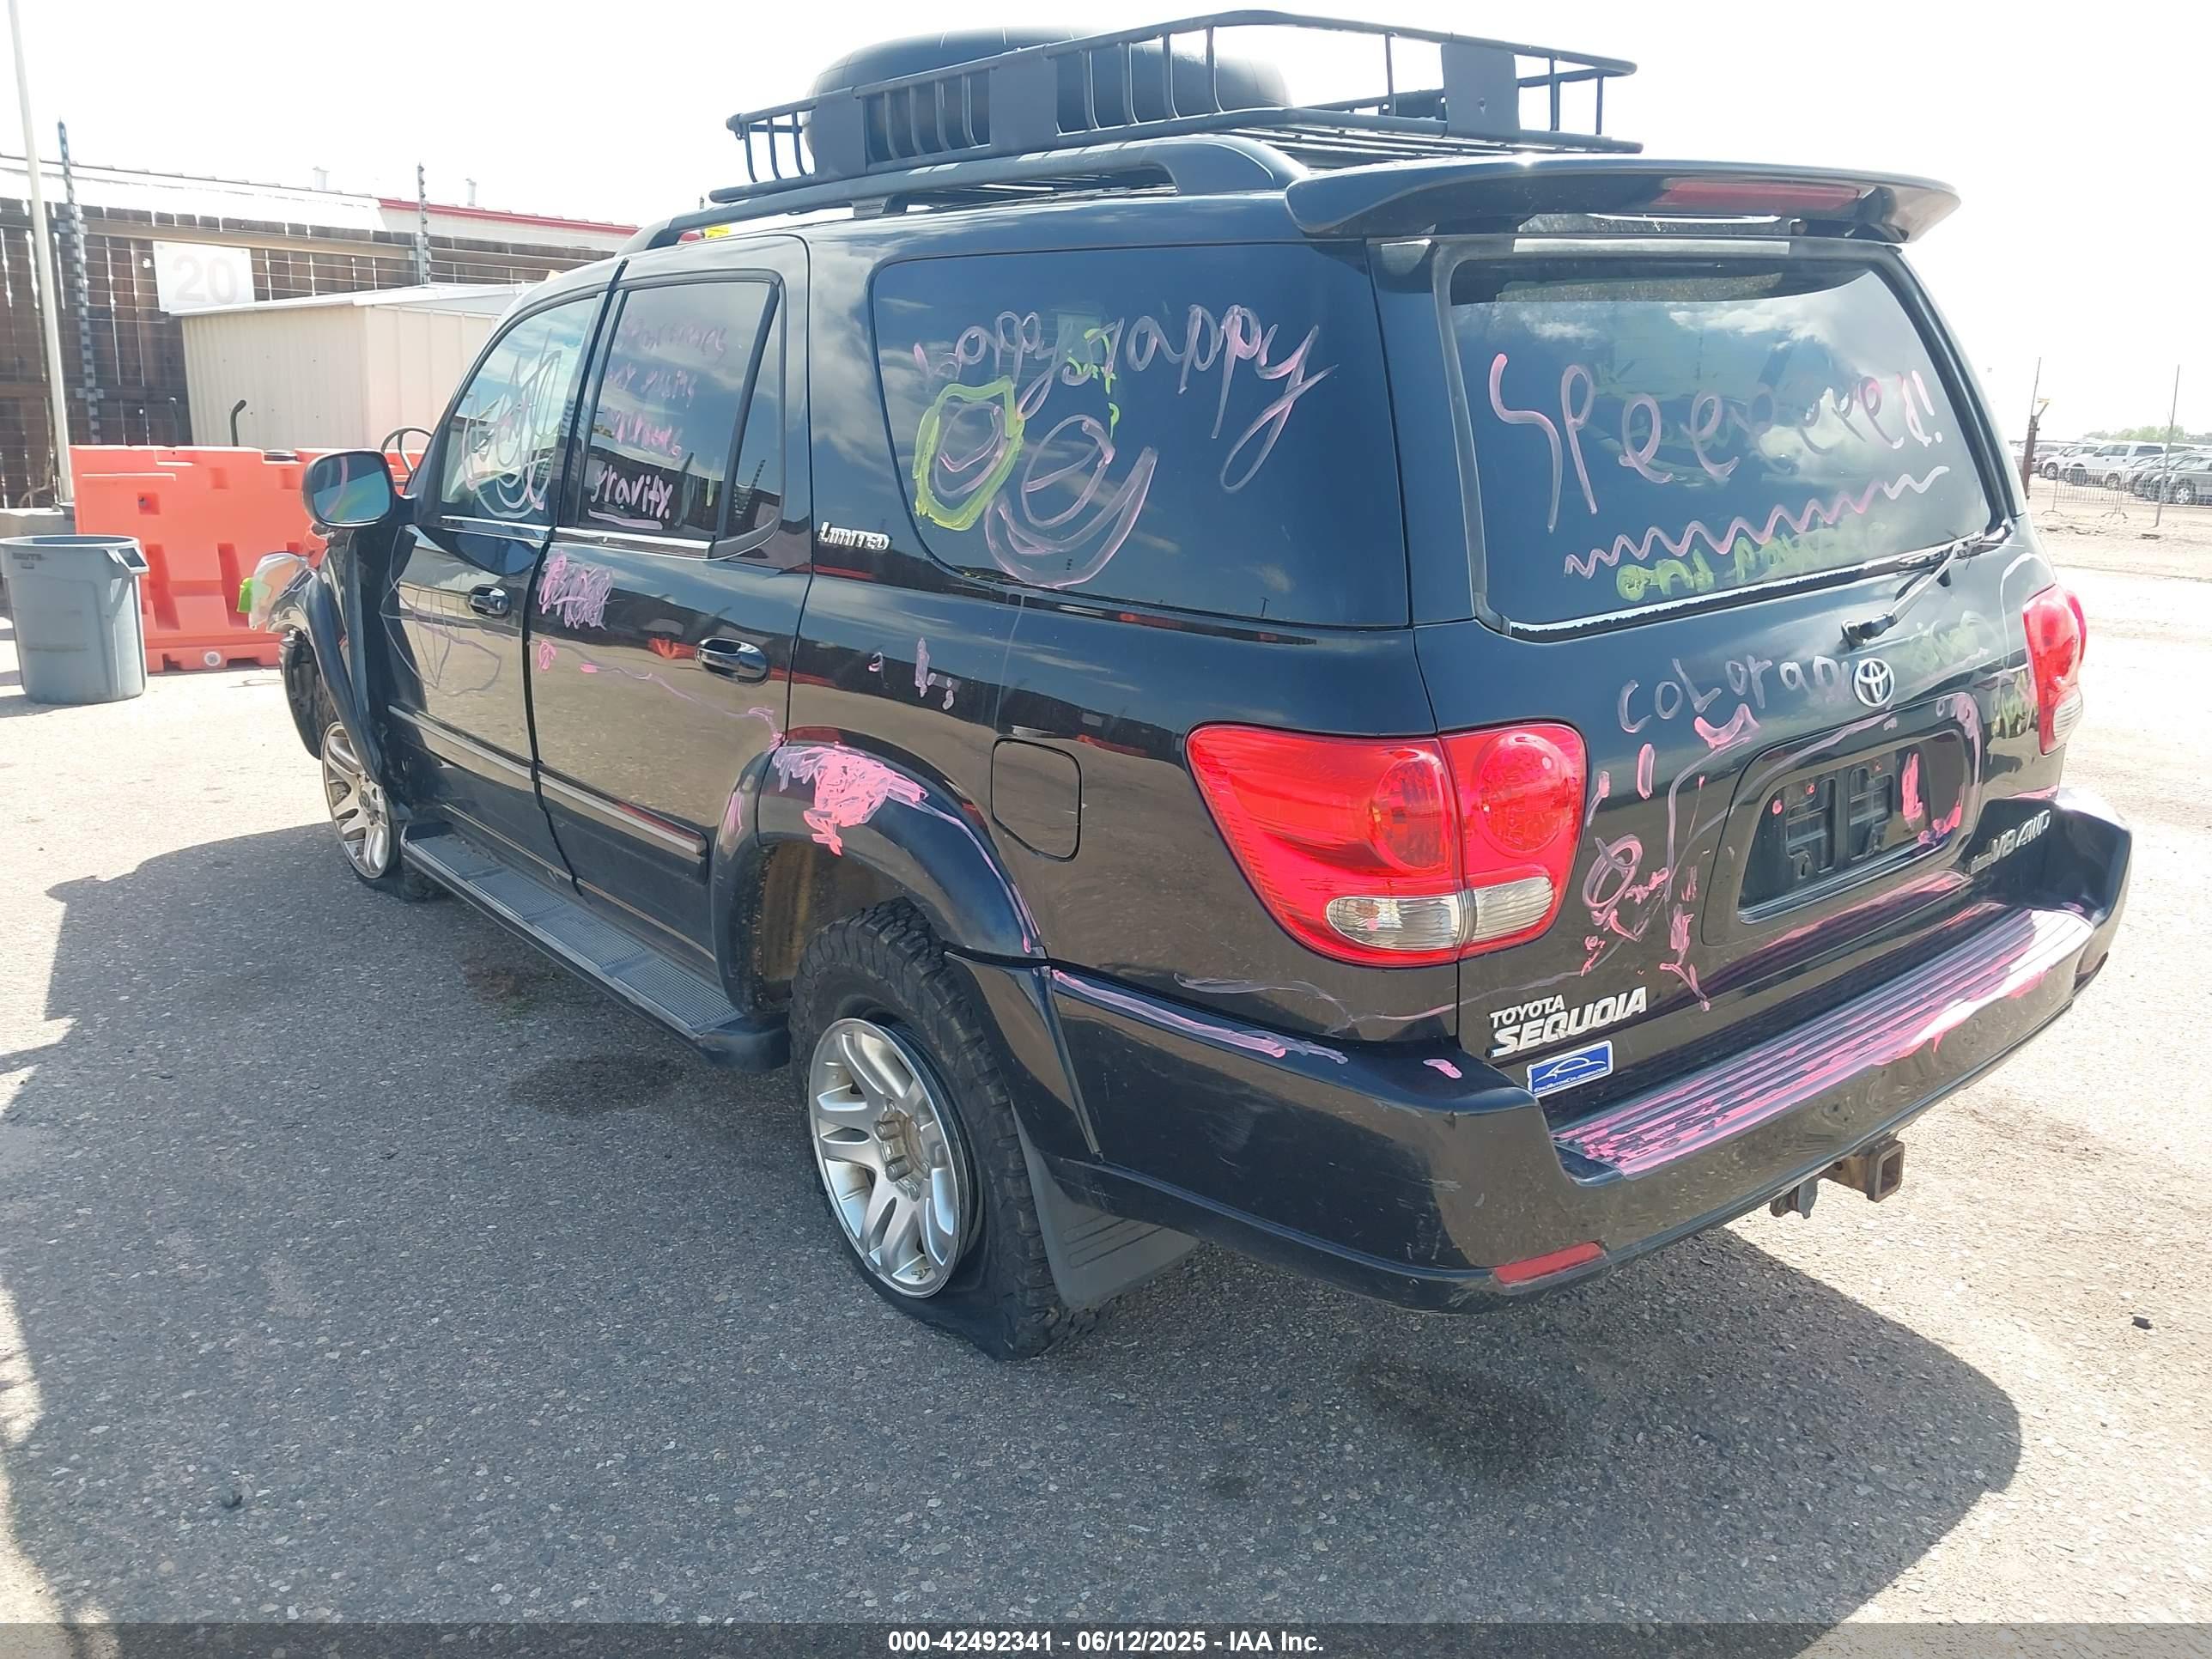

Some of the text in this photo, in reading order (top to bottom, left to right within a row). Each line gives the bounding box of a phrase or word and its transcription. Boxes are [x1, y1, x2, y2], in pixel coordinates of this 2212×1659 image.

[172, 255, 238, 303] 20
[817, 521, 890, 550] LIMITED
[1490, 994, 1565, 1029] TOYOTA
[1490, 987, 1648, 1059] SEQUOIA
